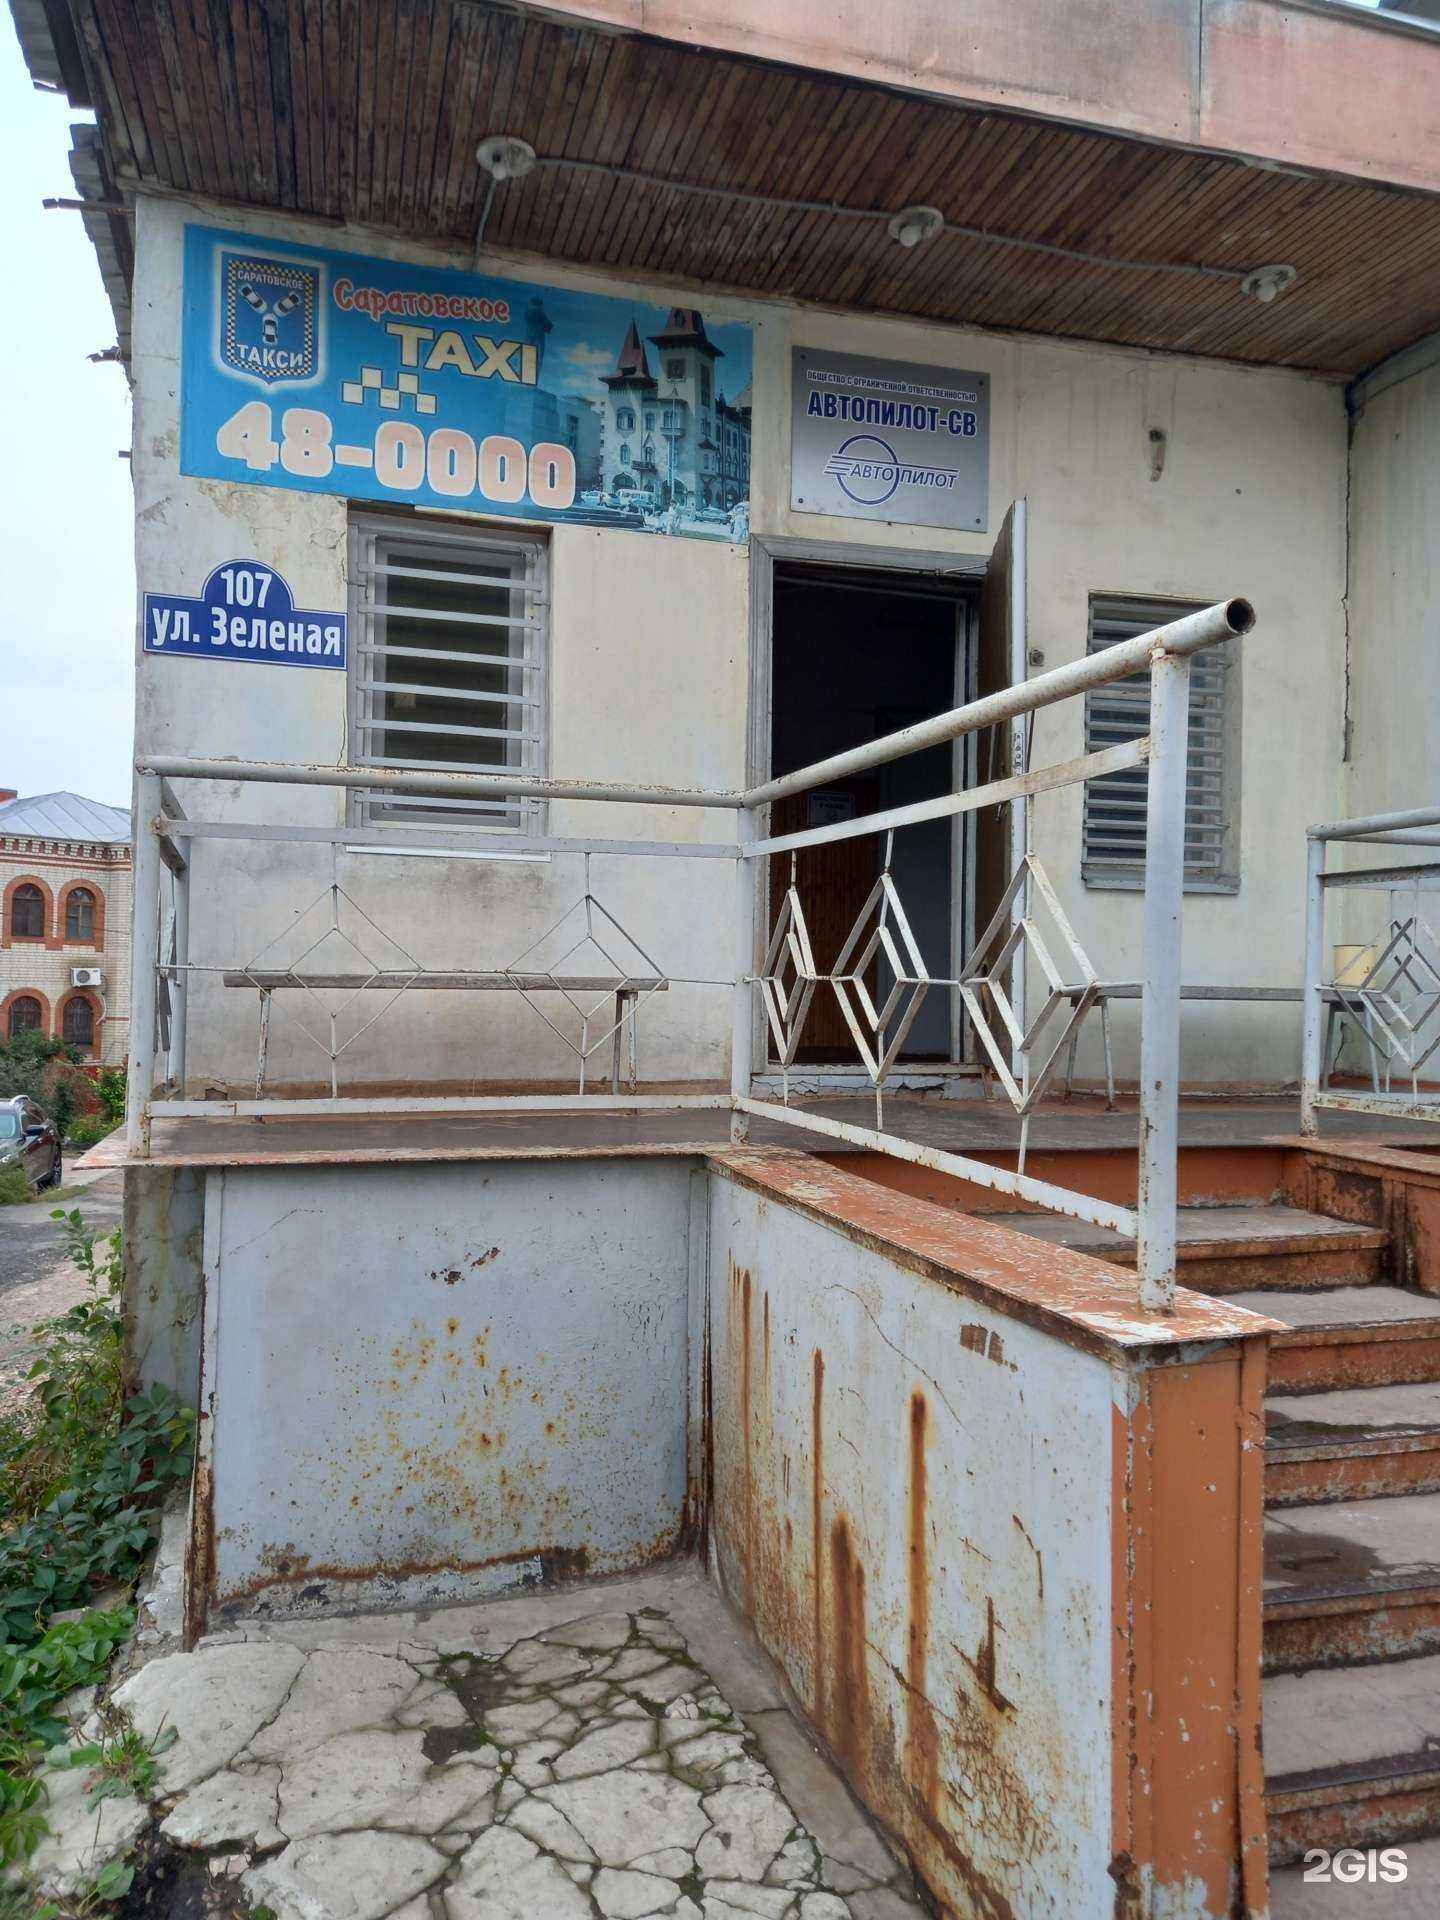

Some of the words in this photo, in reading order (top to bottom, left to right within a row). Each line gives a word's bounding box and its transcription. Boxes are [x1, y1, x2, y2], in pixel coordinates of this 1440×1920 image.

[237, 270, 304, 290] САРАТОВСКОЕ
[333, 278, 511, 323] Саратовское
[236, 343, 304, 368] ТАКСИ
[385, 321, 538, 386] TAXI
[807, 370, 846, 384] ОБЩЕСТВО
[847, 376, 852, 385] С
[853, 377, 908, 393] ОГРАНИЧЕННОЙ
[909, 384, 977, 402] ОТВЕТСТВЕННОСТЬЮ
[807, 390, 977, 437] АВТОПИЛОТ-СВ
[216, 401, 576, 509] 48-0000
[220, 568, 273, 608] 107
[152, 607, 200, 646] ул.
[211, 606, 341, 656] Зеленая
